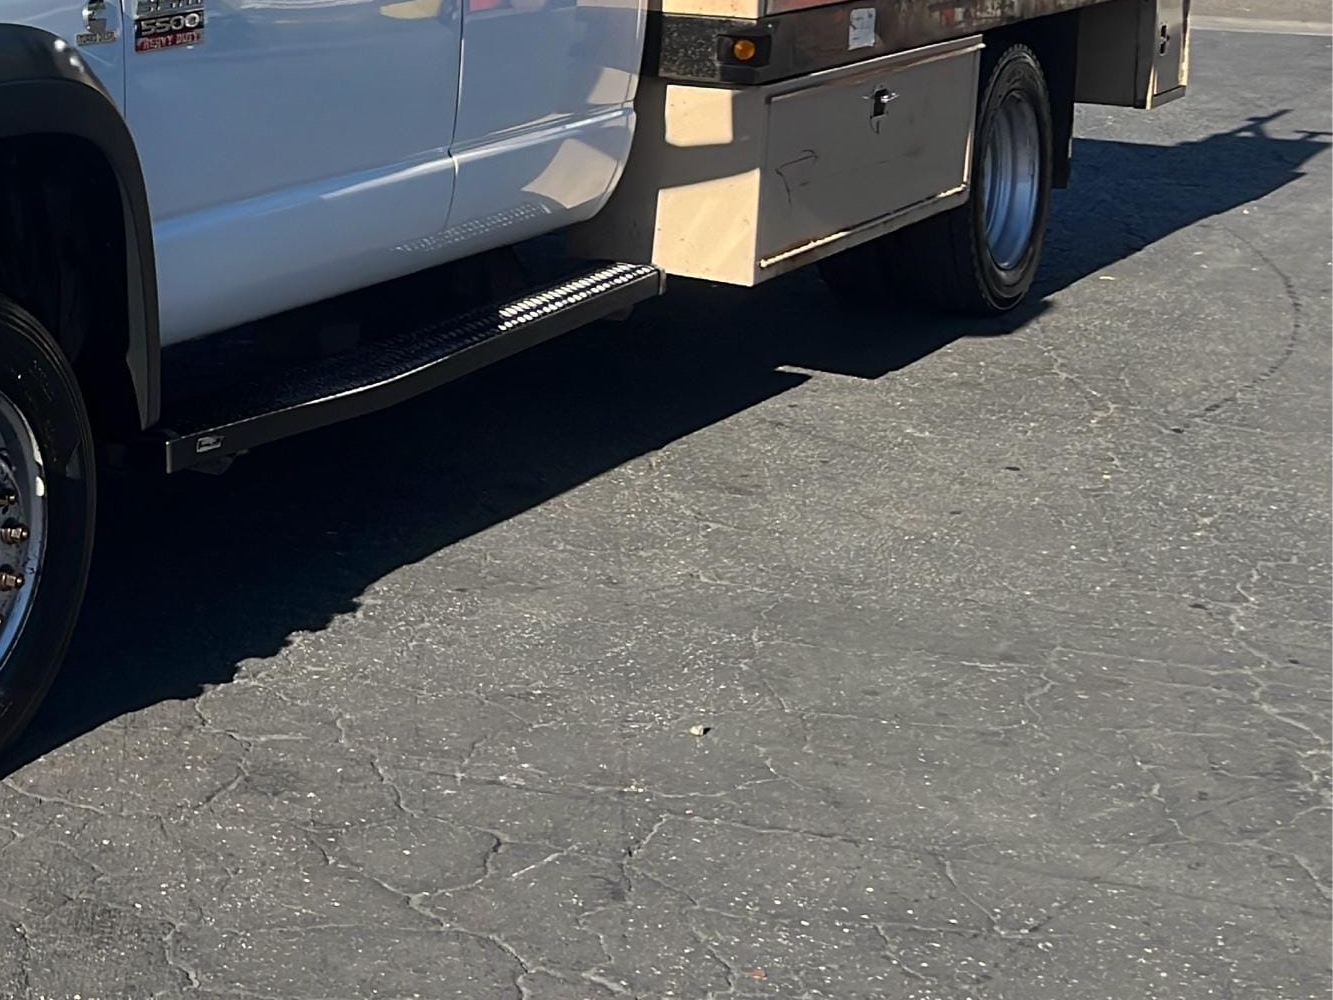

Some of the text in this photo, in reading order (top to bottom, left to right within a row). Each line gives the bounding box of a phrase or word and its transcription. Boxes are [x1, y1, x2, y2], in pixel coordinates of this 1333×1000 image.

[140, 13, 201, 36] 5500
[142, 30, 199, 49] HEAVY DUTY
